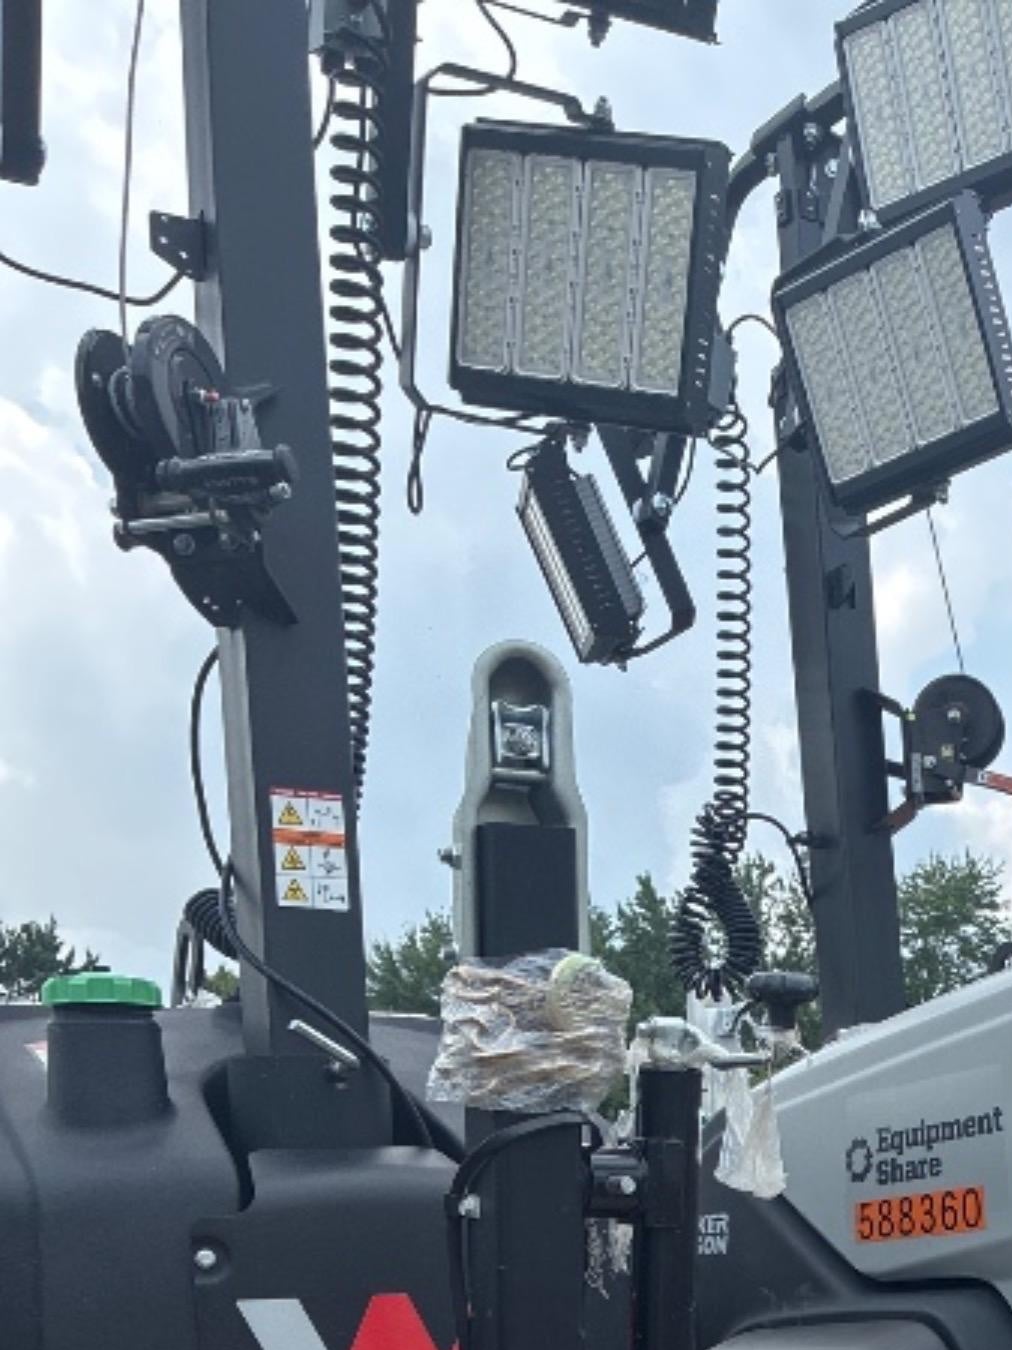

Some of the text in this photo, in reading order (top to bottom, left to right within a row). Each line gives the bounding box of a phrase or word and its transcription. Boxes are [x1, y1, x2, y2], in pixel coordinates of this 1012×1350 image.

[875, 1106, 1004, 1156] Equipment
[876, 1154, 943, 1186] Share
[857, 1187, 984, 1241] 588360
